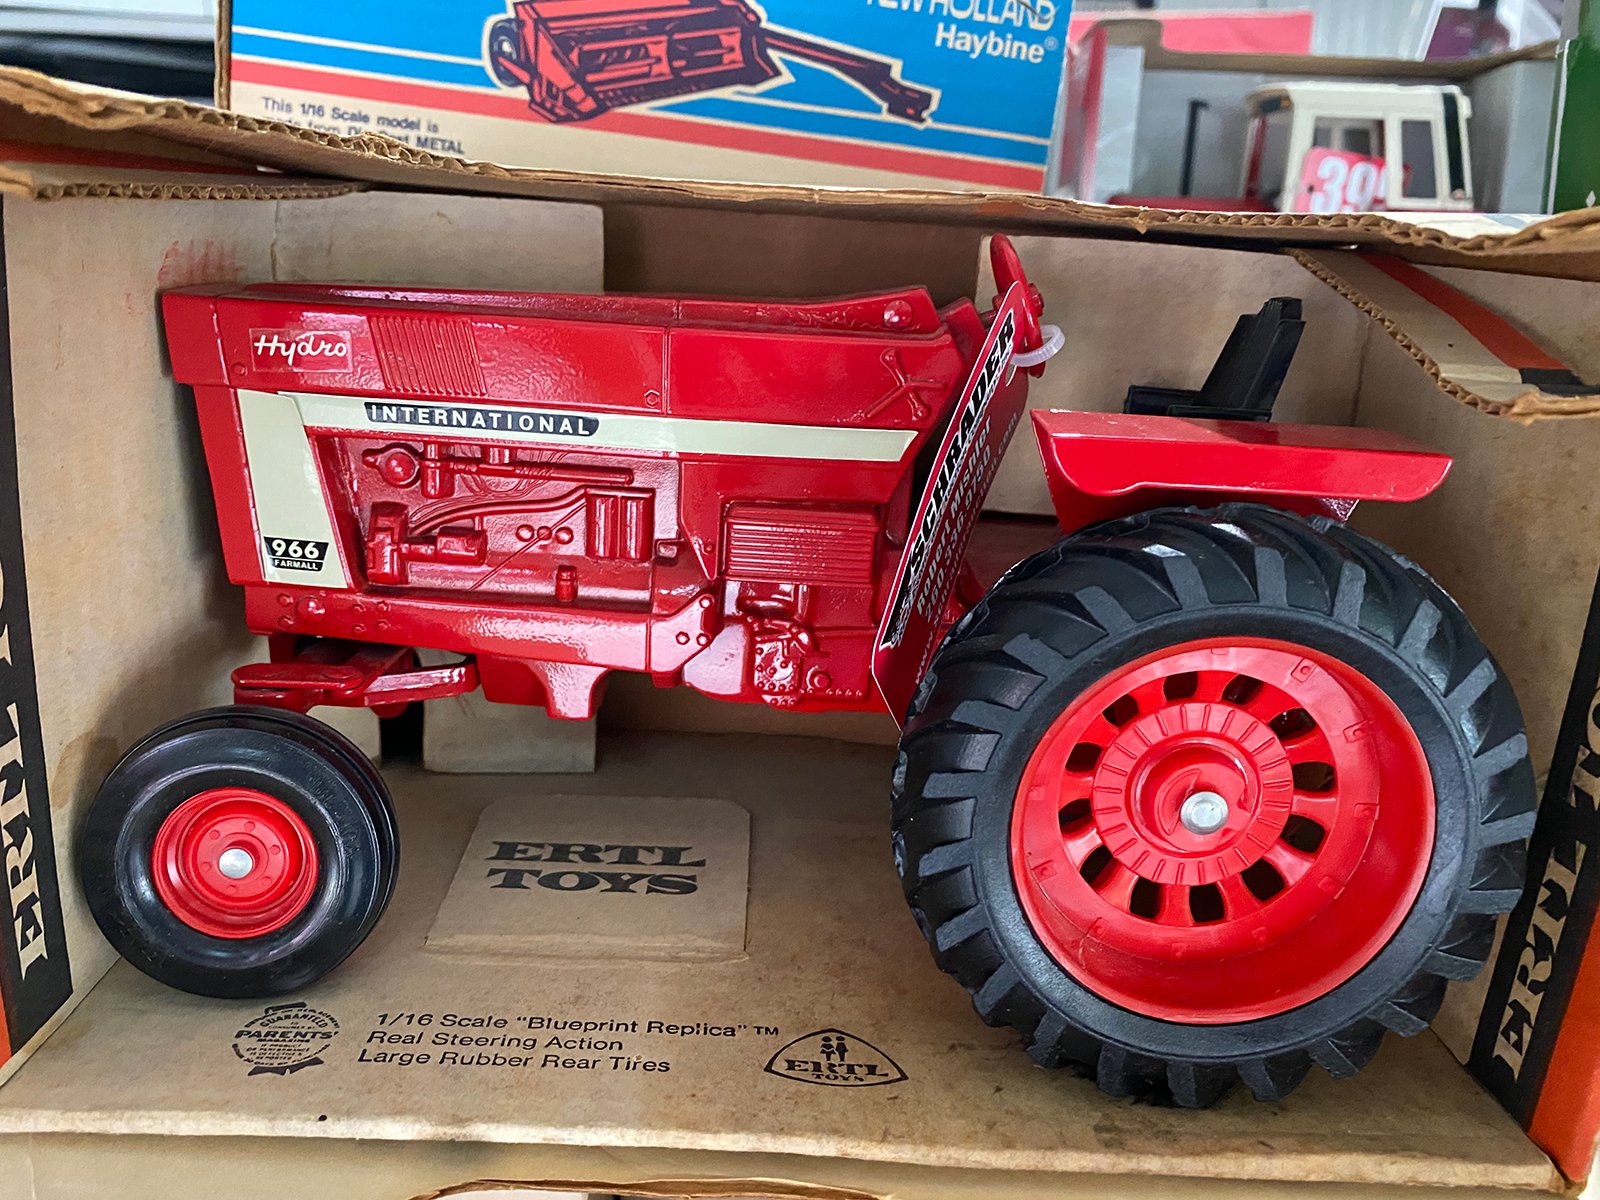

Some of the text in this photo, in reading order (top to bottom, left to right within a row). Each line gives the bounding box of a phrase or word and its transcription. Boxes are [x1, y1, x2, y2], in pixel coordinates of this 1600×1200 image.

[262, 96, 439, 133] This 1/16 Scale model is
[416, 136, 465, 155] METAL
[1310, 155, 1388, 213] 39
[254, 334, 347, 366] Hydro
[370, 404, 591, 436] INTERNATIONAL
[910, 311, 1014, 577] SCHRADER
[917, 416, 991, 616] Robert Mishler
[272, 539, 319, 559] 966
[274, 559, 319, 570] FARMALL
[484, 841, 706, 867] ERTL
[487, 867, 698, 895] TOYS
[1493, 840, 1587, 1083] ERTL
[377, 1012, 434, 1026] 1/16
[440, 1014, 509, 1028] Scale
[366, 1030, 623, 1051] Real Steering Action
[357, 1049, 671, 1073] Large Rubber Rear Tires
[784, 1059, 889, 1077] ERTL
[811, 1073, 865, 1082] TOYS
